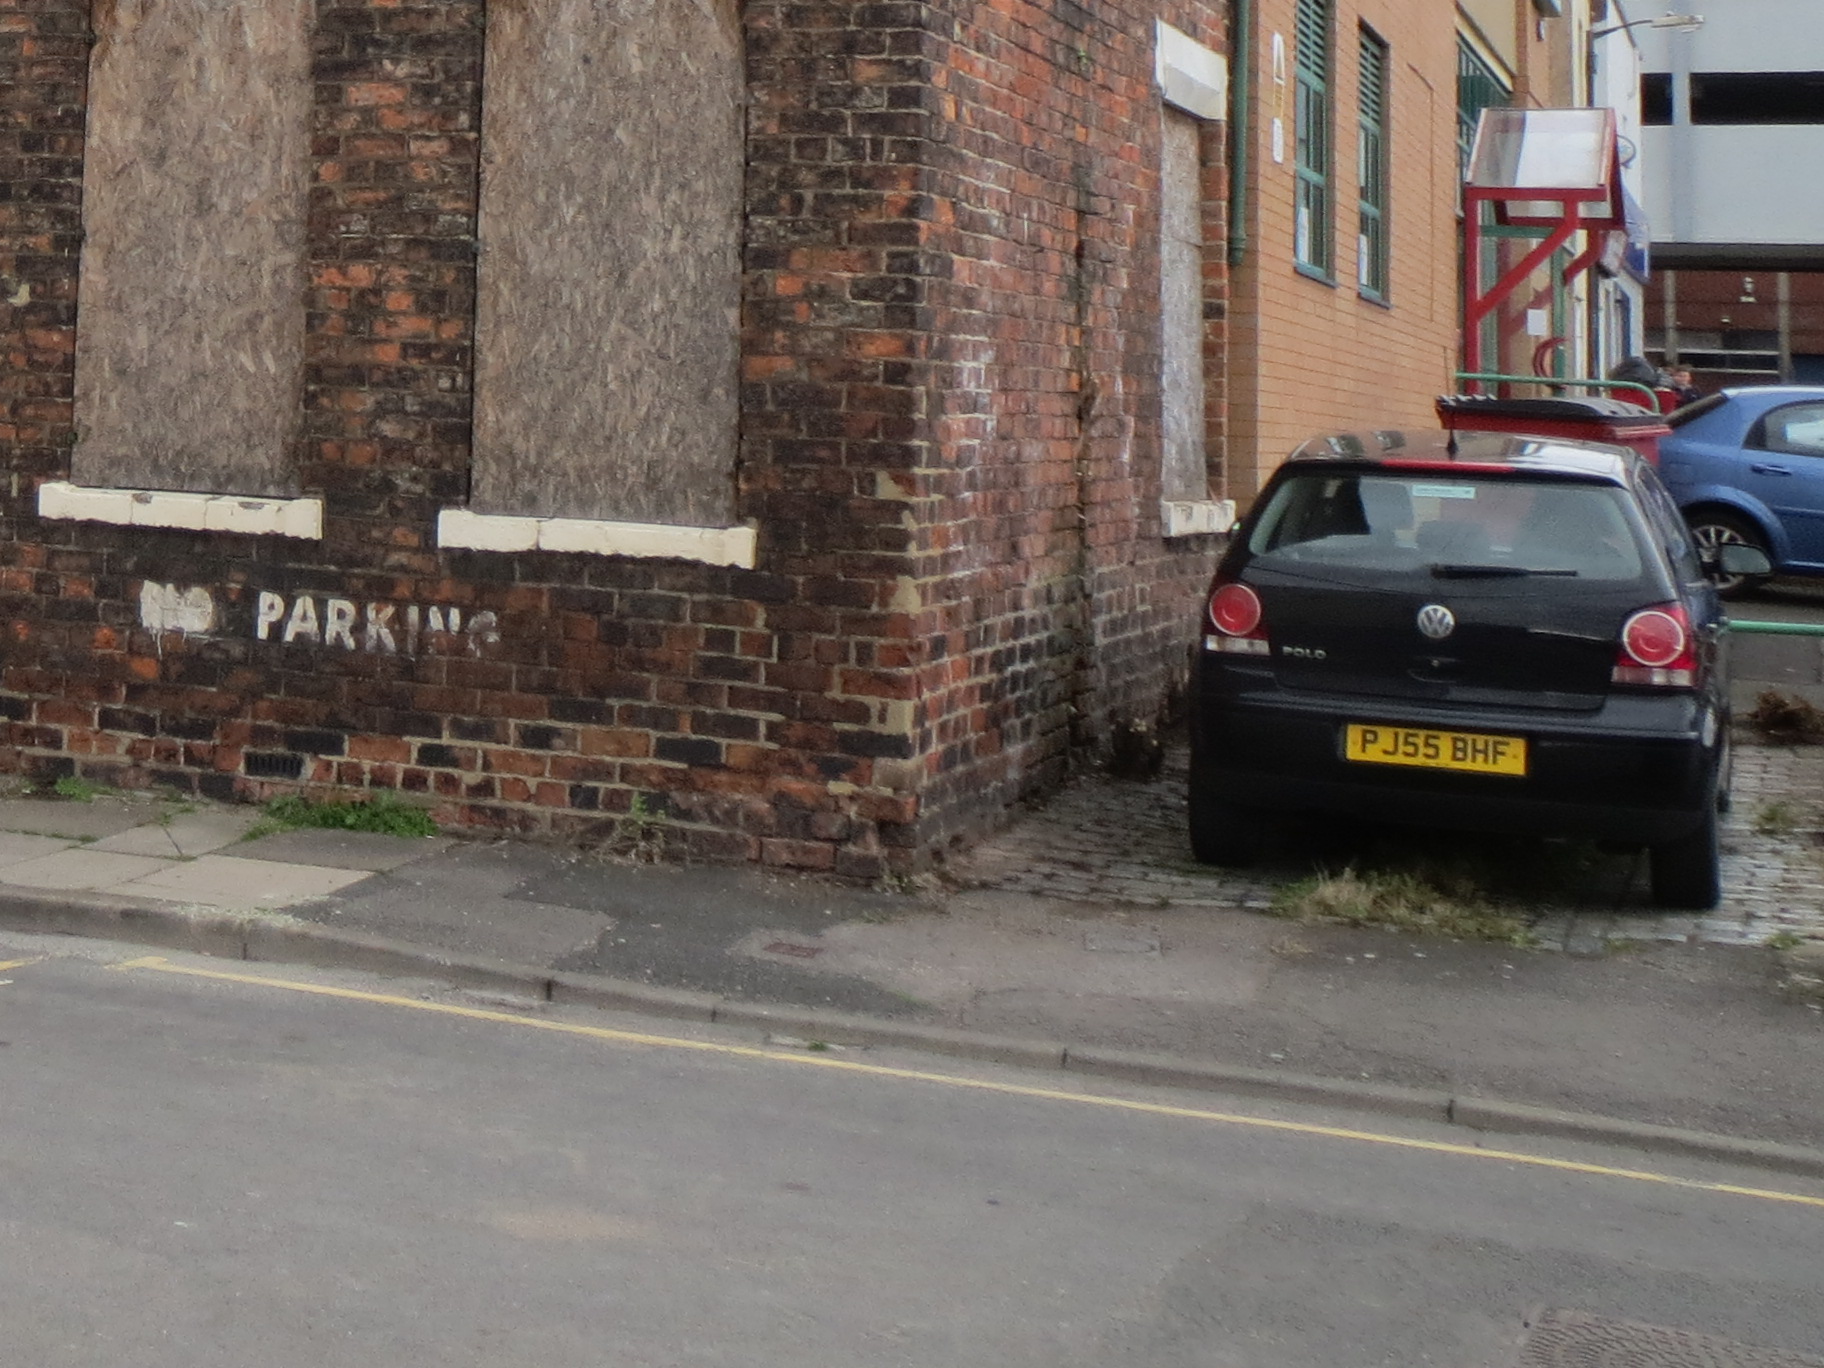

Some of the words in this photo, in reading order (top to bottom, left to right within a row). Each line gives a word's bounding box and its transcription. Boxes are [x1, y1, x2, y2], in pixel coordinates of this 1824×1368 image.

[1282, 645, 1327, 660] POLO
[1360, 728, 1441, 760] PJ55
[1450, 736, 1511, 765] BHF
